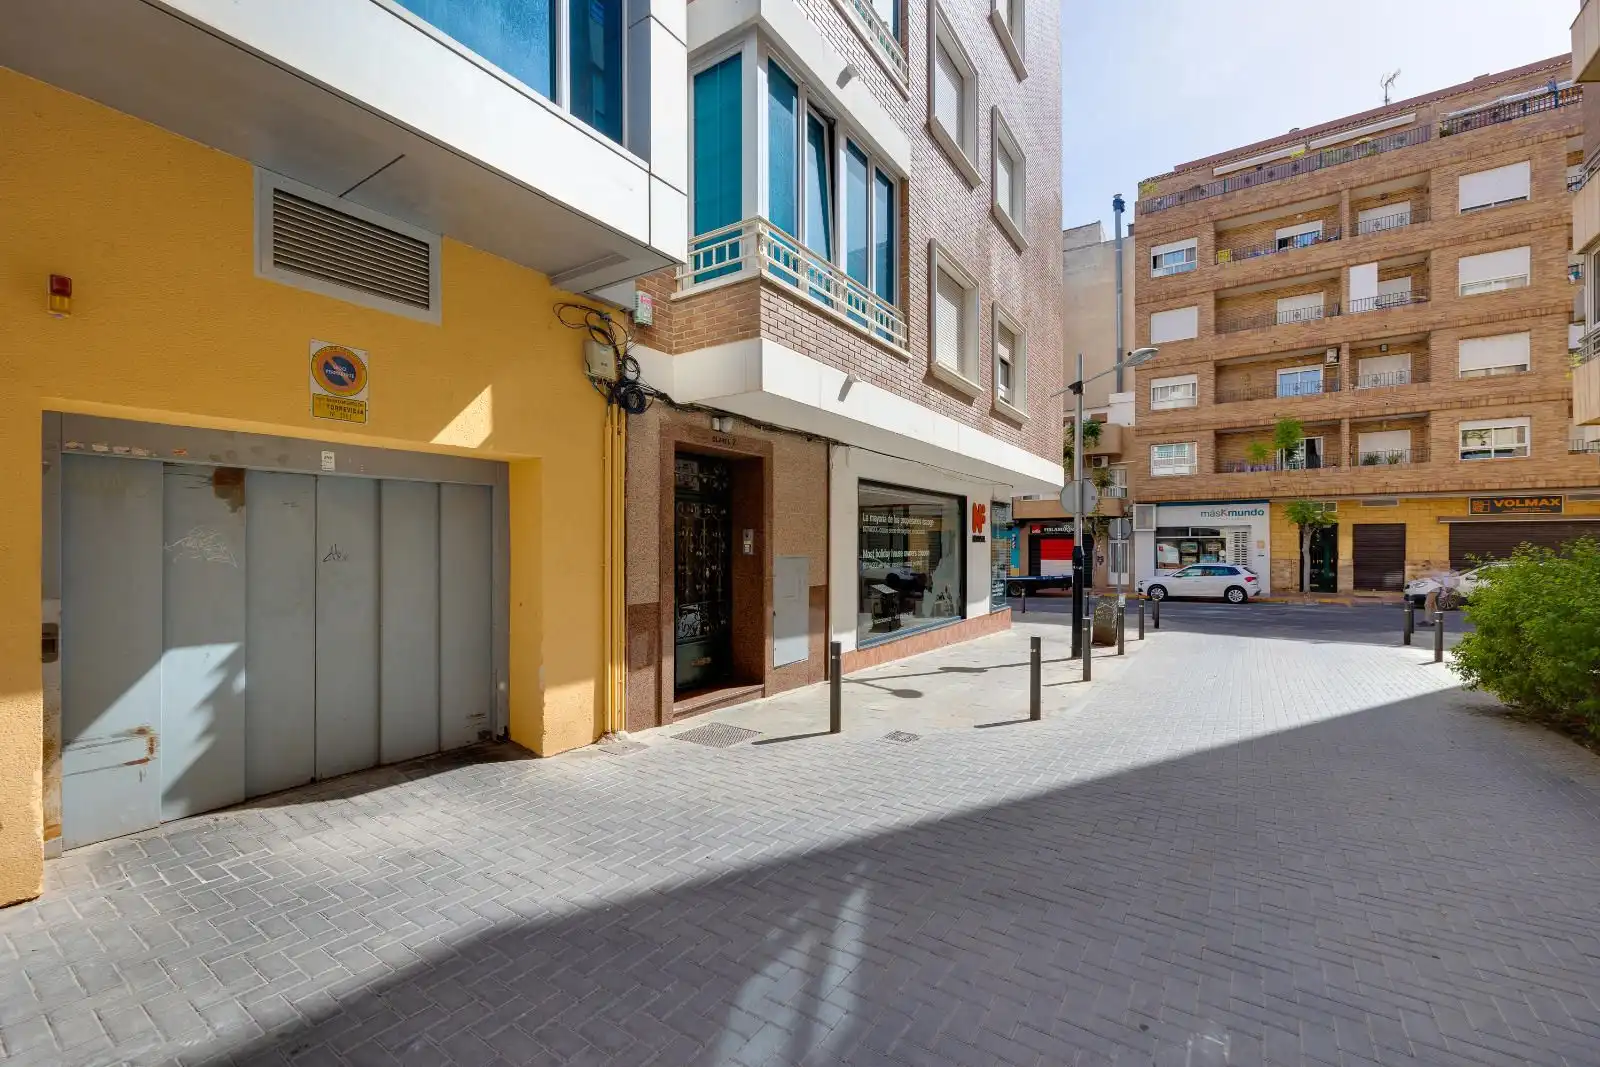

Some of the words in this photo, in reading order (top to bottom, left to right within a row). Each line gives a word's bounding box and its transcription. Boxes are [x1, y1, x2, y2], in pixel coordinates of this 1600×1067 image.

[1493, 498, 1560, 507] VOLMAX
[862, 512, 868, 522] La
[887, 514, 894, 524] de
